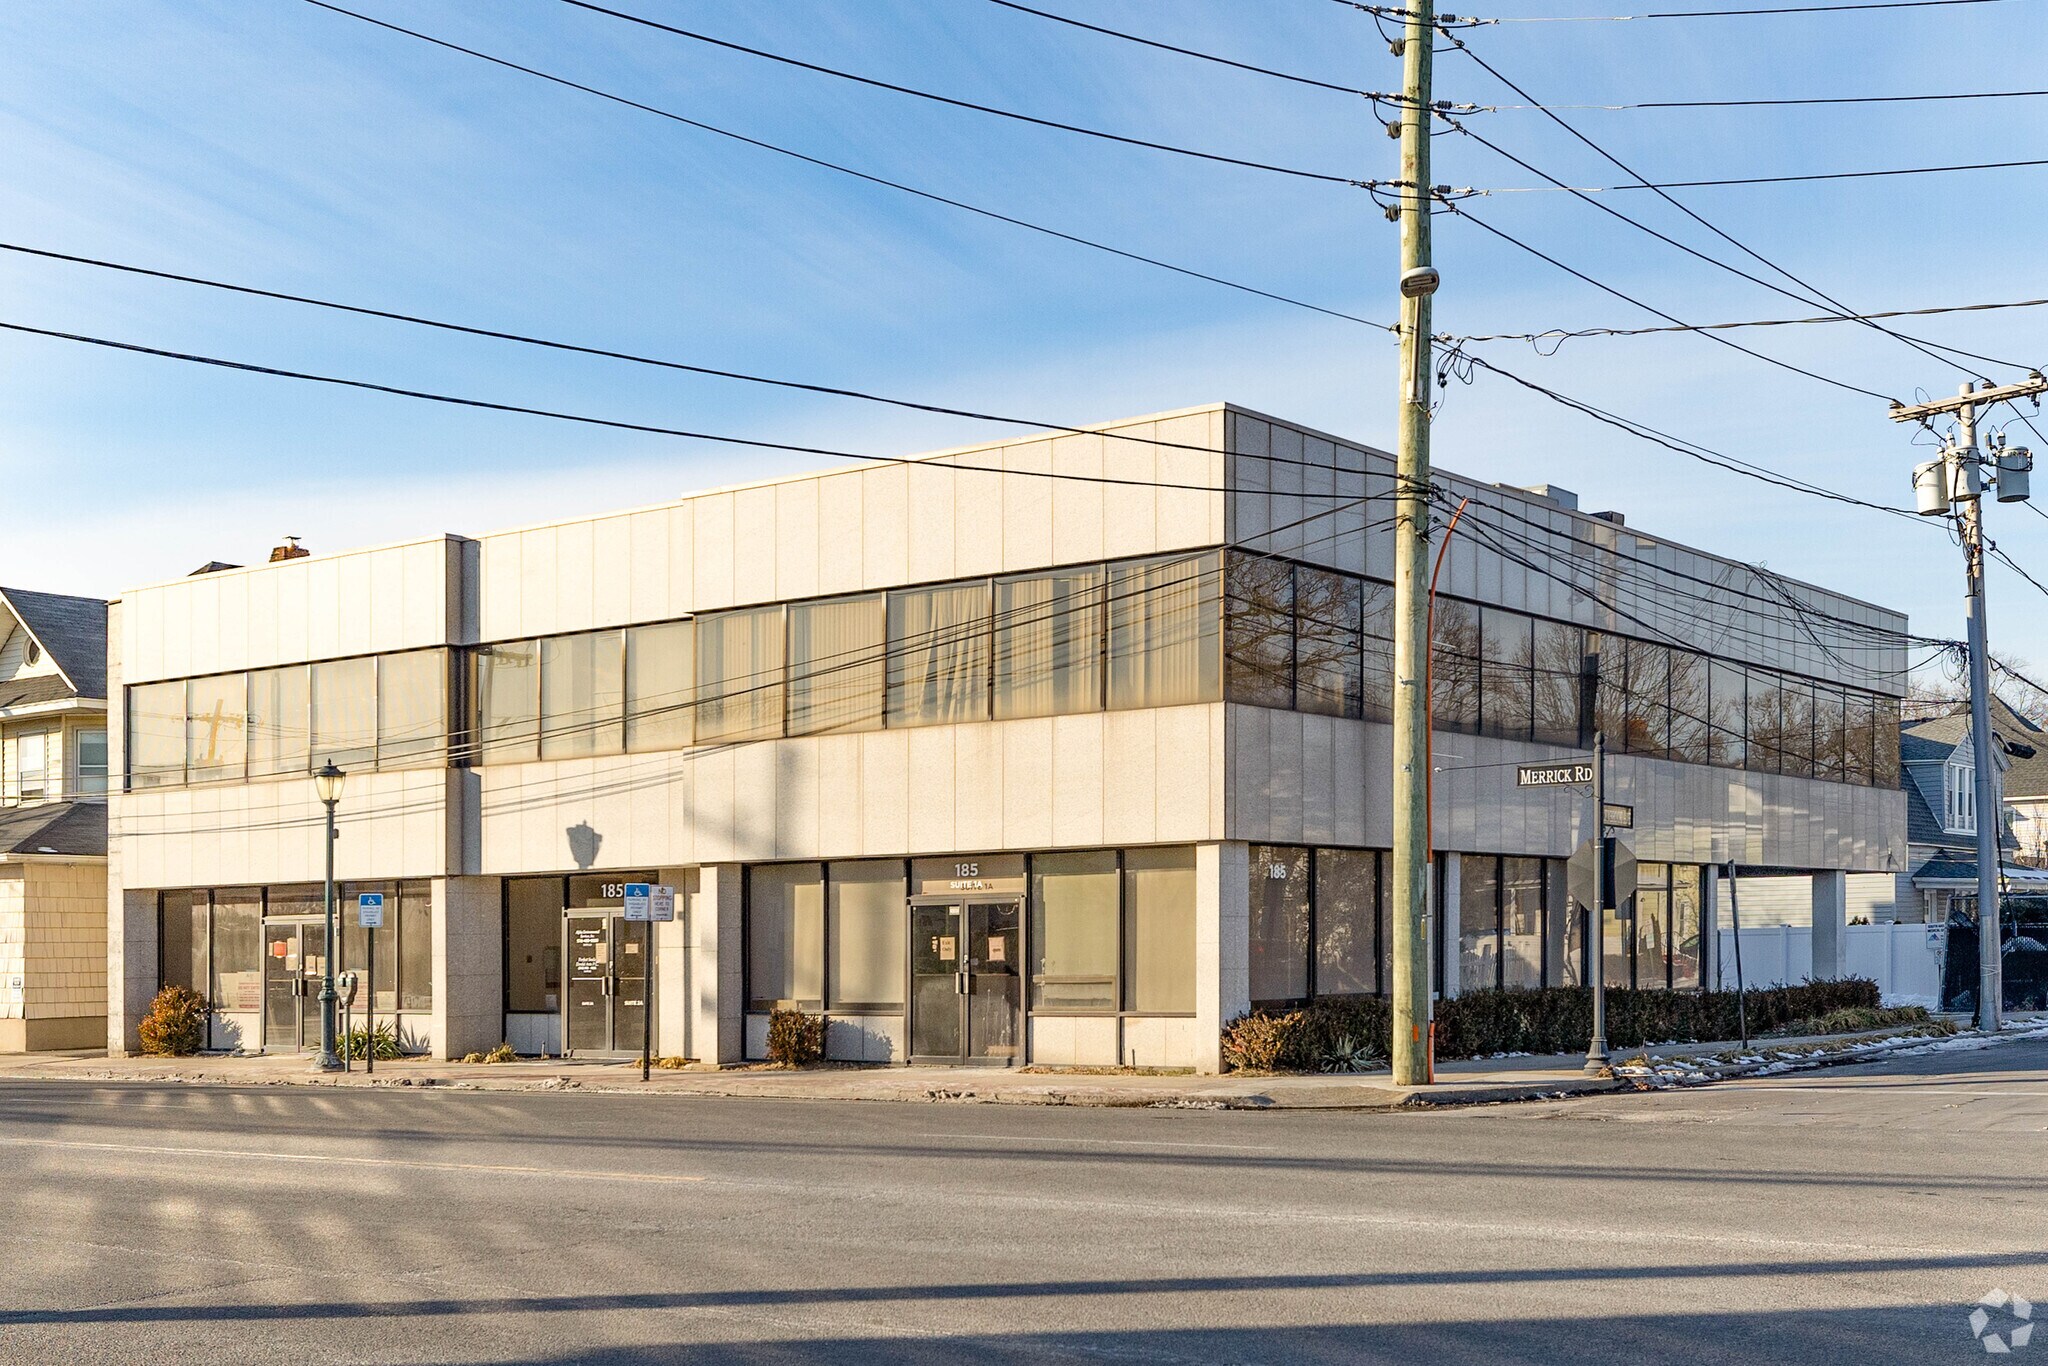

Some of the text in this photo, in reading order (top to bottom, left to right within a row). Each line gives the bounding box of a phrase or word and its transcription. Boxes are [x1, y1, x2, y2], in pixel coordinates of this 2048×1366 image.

[1520, 766, 1593, 785] MERRICK RD
[955, 863, 978, 877] 185
[1270, 864, 1286, 879] 185
[601, 884, 623, 898] 185
[950, 880, 983, 889] SUITE 1A
